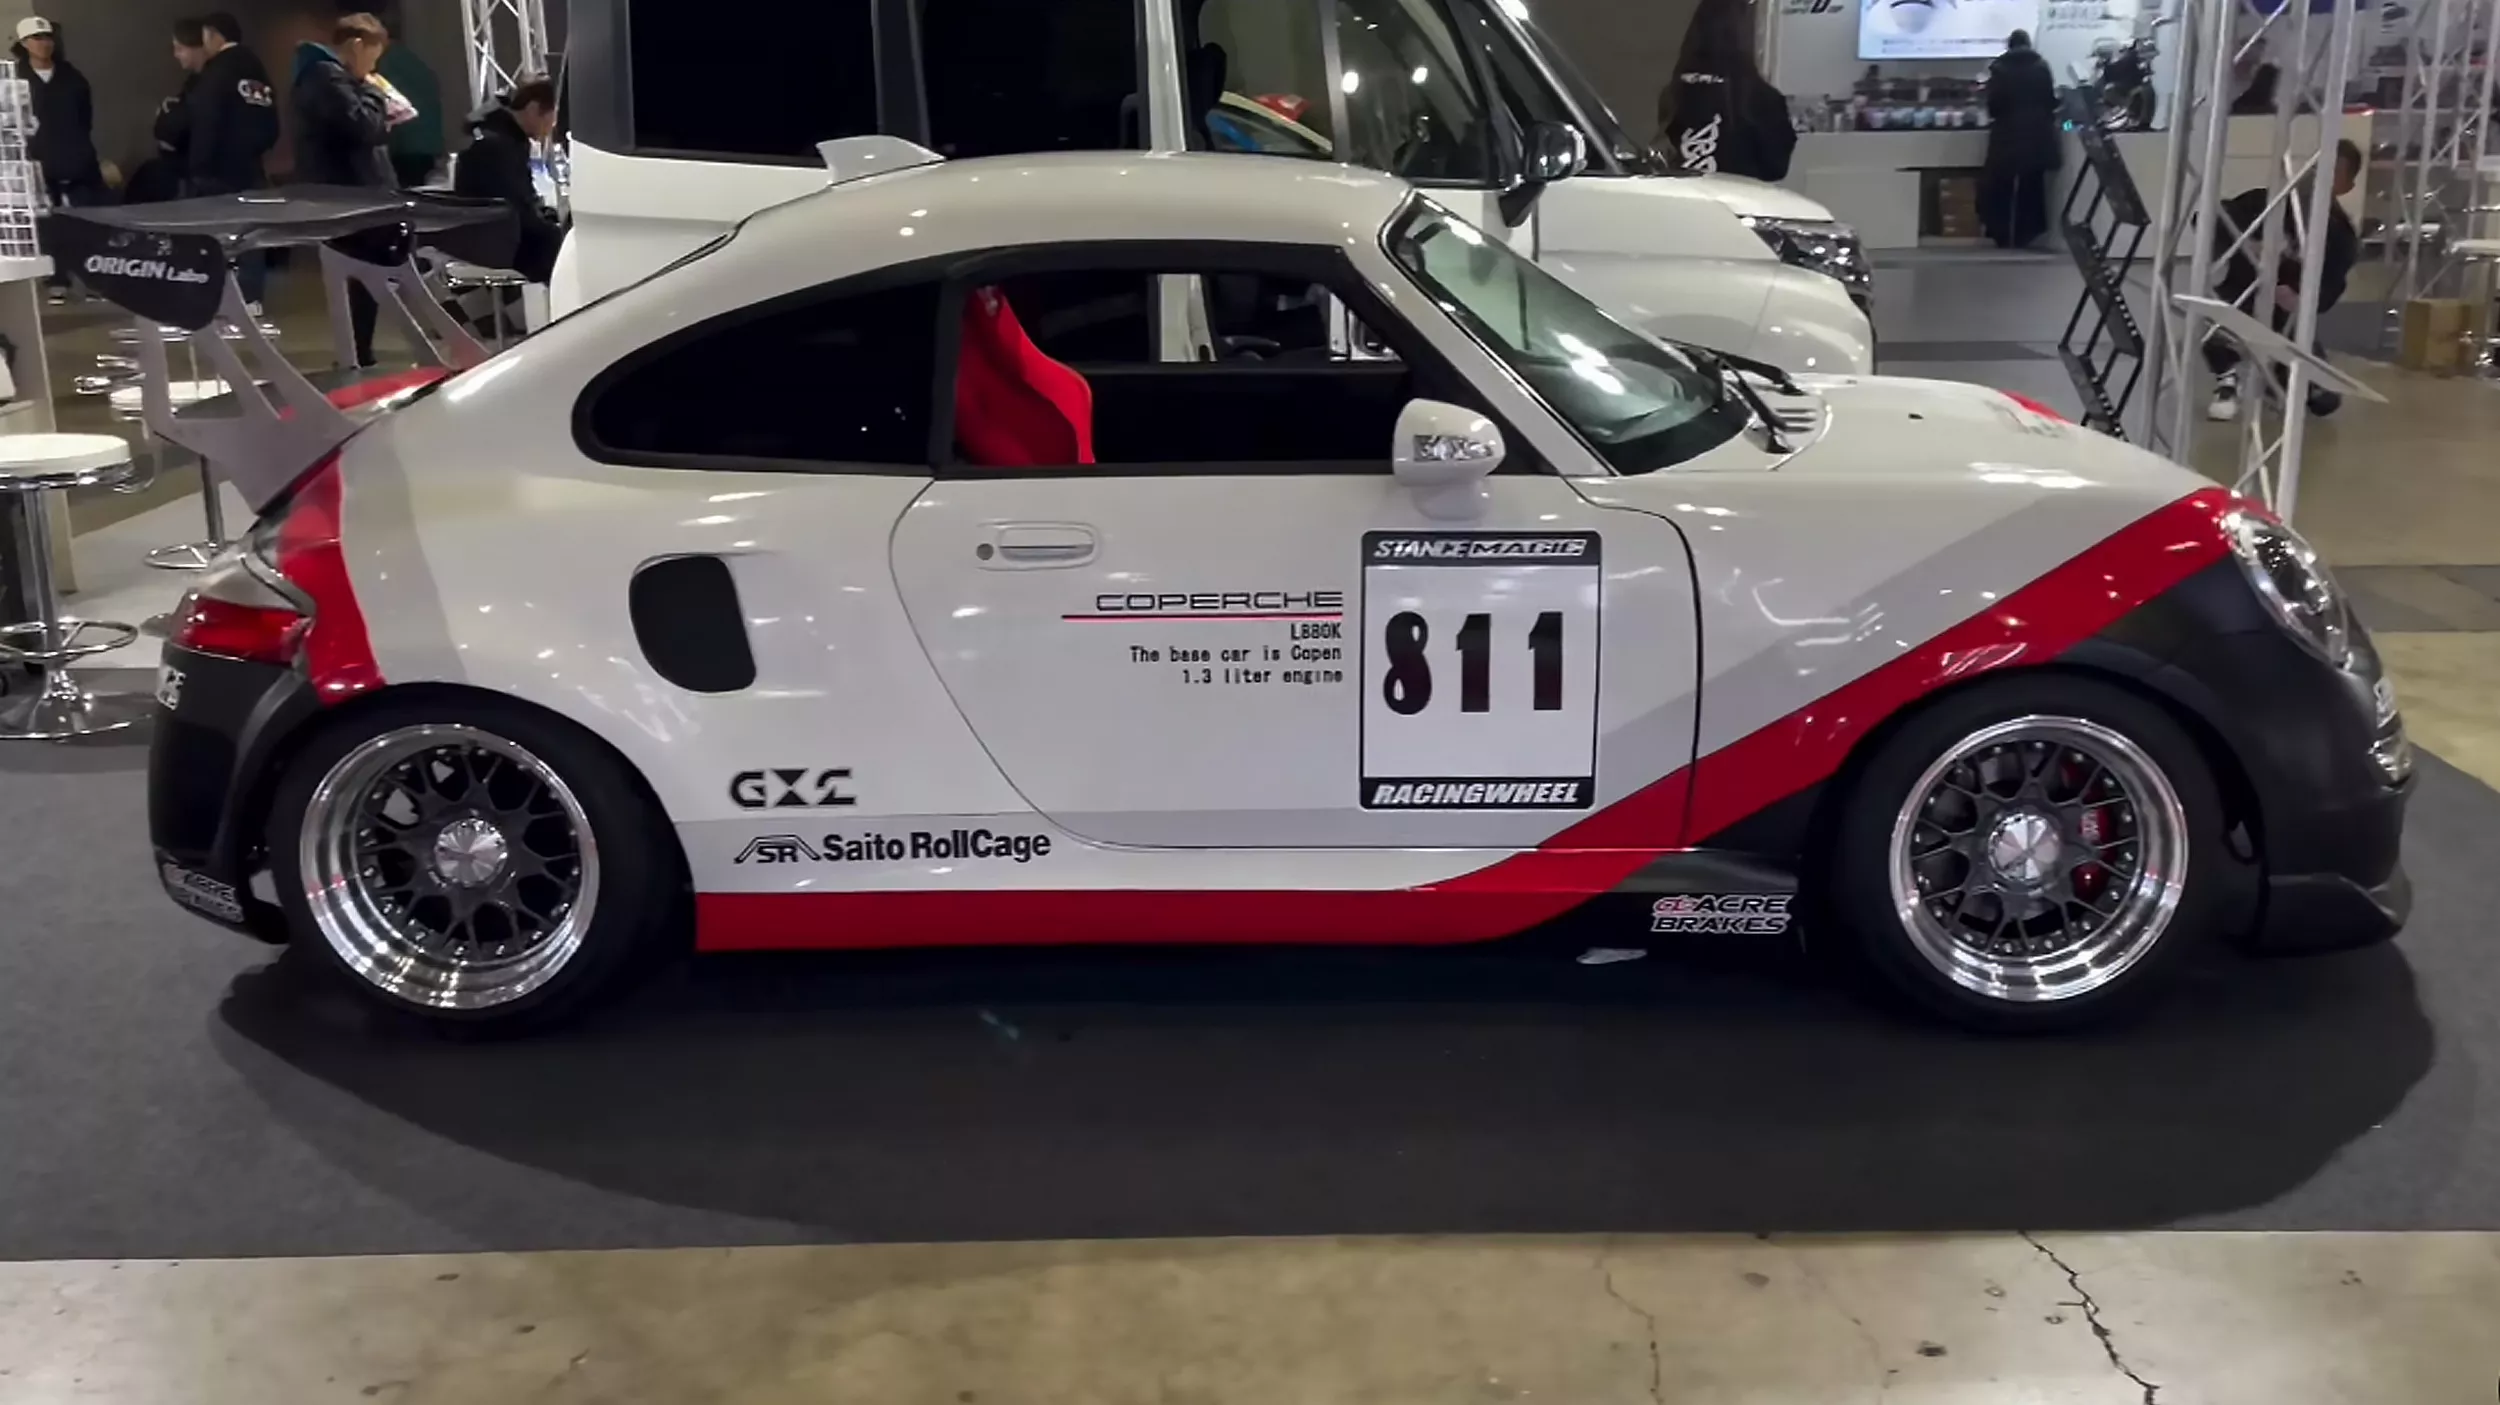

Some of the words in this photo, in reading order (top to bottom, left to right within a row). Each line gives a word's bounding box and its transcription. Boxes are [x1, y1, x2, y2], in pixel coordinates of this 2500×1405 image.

[84, 255, 166, 280] ORIGIN
[1096, 592, 1343, 611] COPERCHE
[1290, 622, 1342, 641] L880K
[1130, 645, 1161, 663] The
[1169, 645, 1211, 663] base
[1220, 648, 1251, 663] car
[1263, 645, 1281, 662] is
[1290, 644, 1342, 663] Copen
[1383, 610, 1564, 715] 811
[1182, 668, 1212, 684] 1.3
[1224, 668, 1272, 684] liter
[1282, 668, 1343, 685] engine
[822, 833, 906, 862] Saito
[1651, 915, 1788, 933] BRAKES
